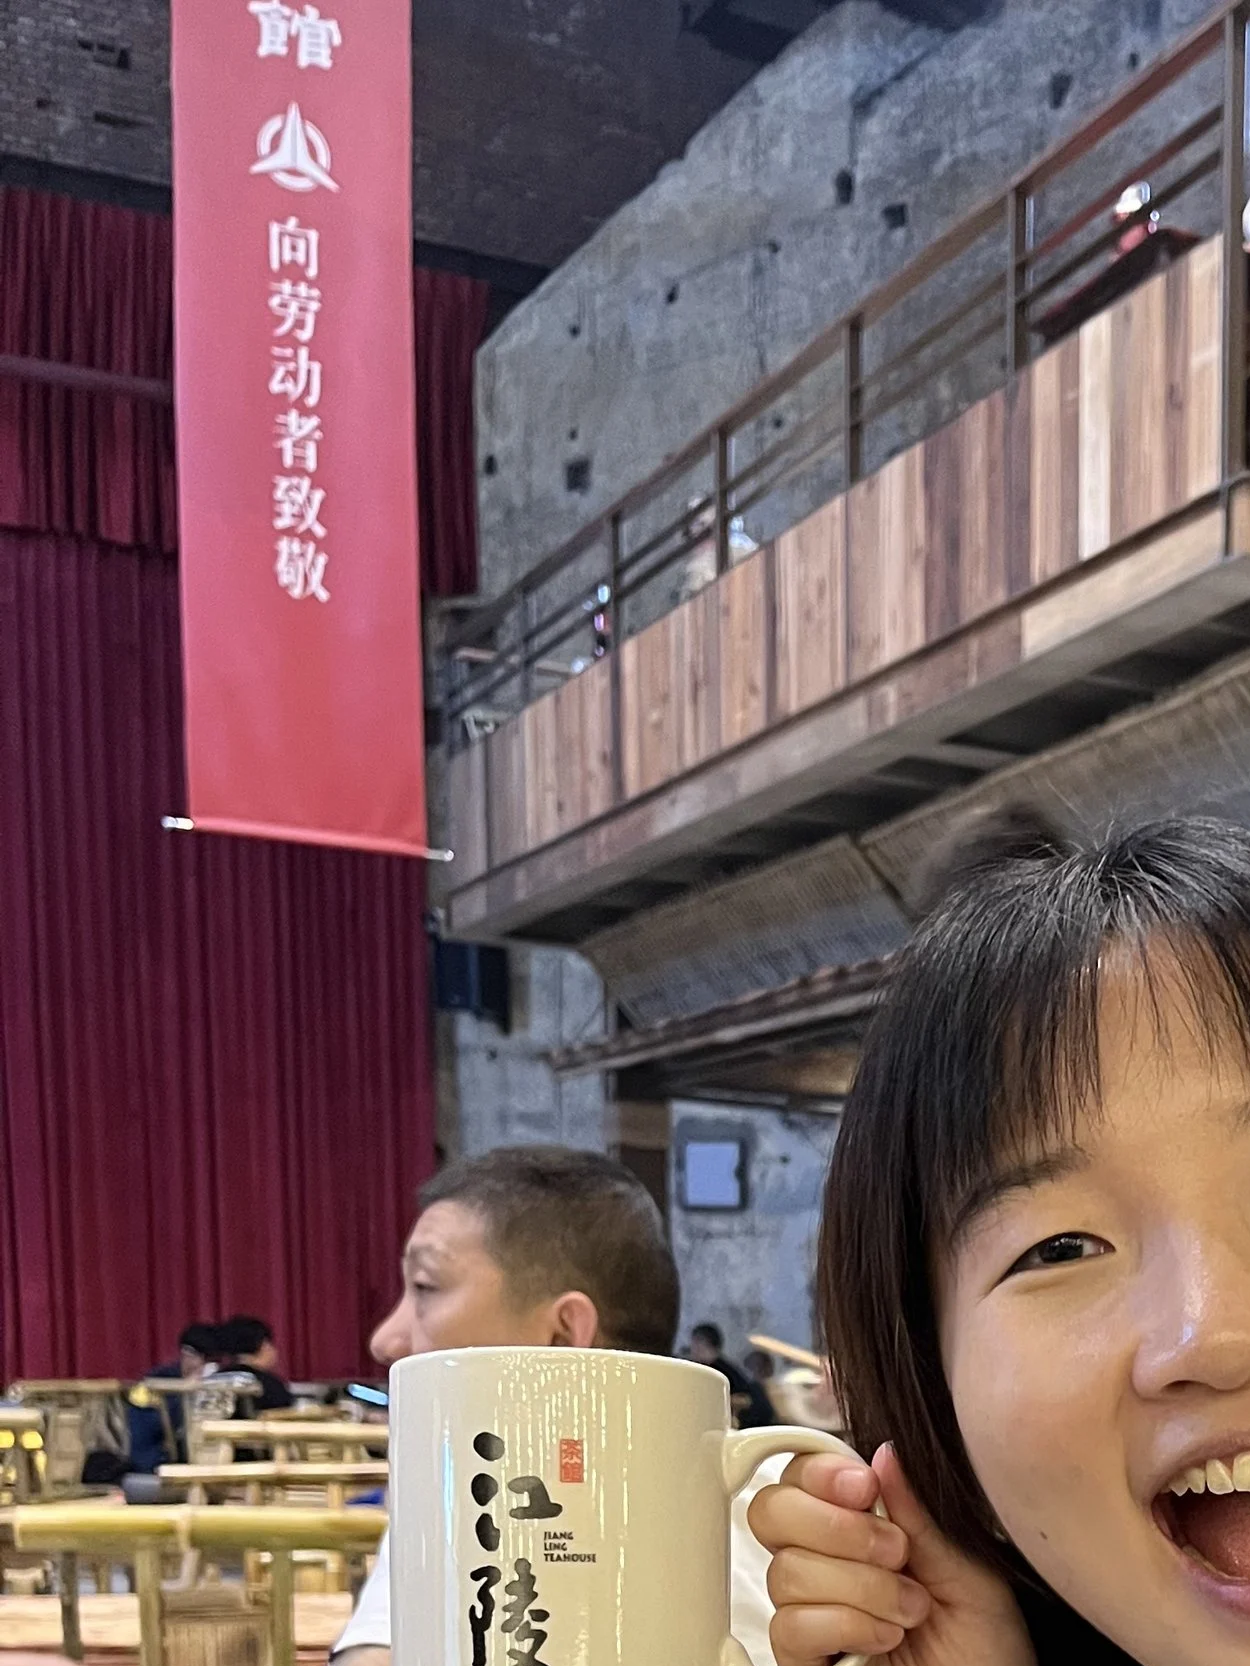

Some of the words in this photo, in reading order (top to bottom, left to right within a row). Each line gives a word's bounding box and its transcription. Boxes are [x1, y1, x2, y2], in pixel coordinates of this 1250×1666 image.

[267, 215, 331, 603] 向劳动者致敬
[543, 1531, 574, 1541] JIANG
[543, 1542, 568, 1551] LING
[543, 1553, 597, 1563] TEAHOUSE
